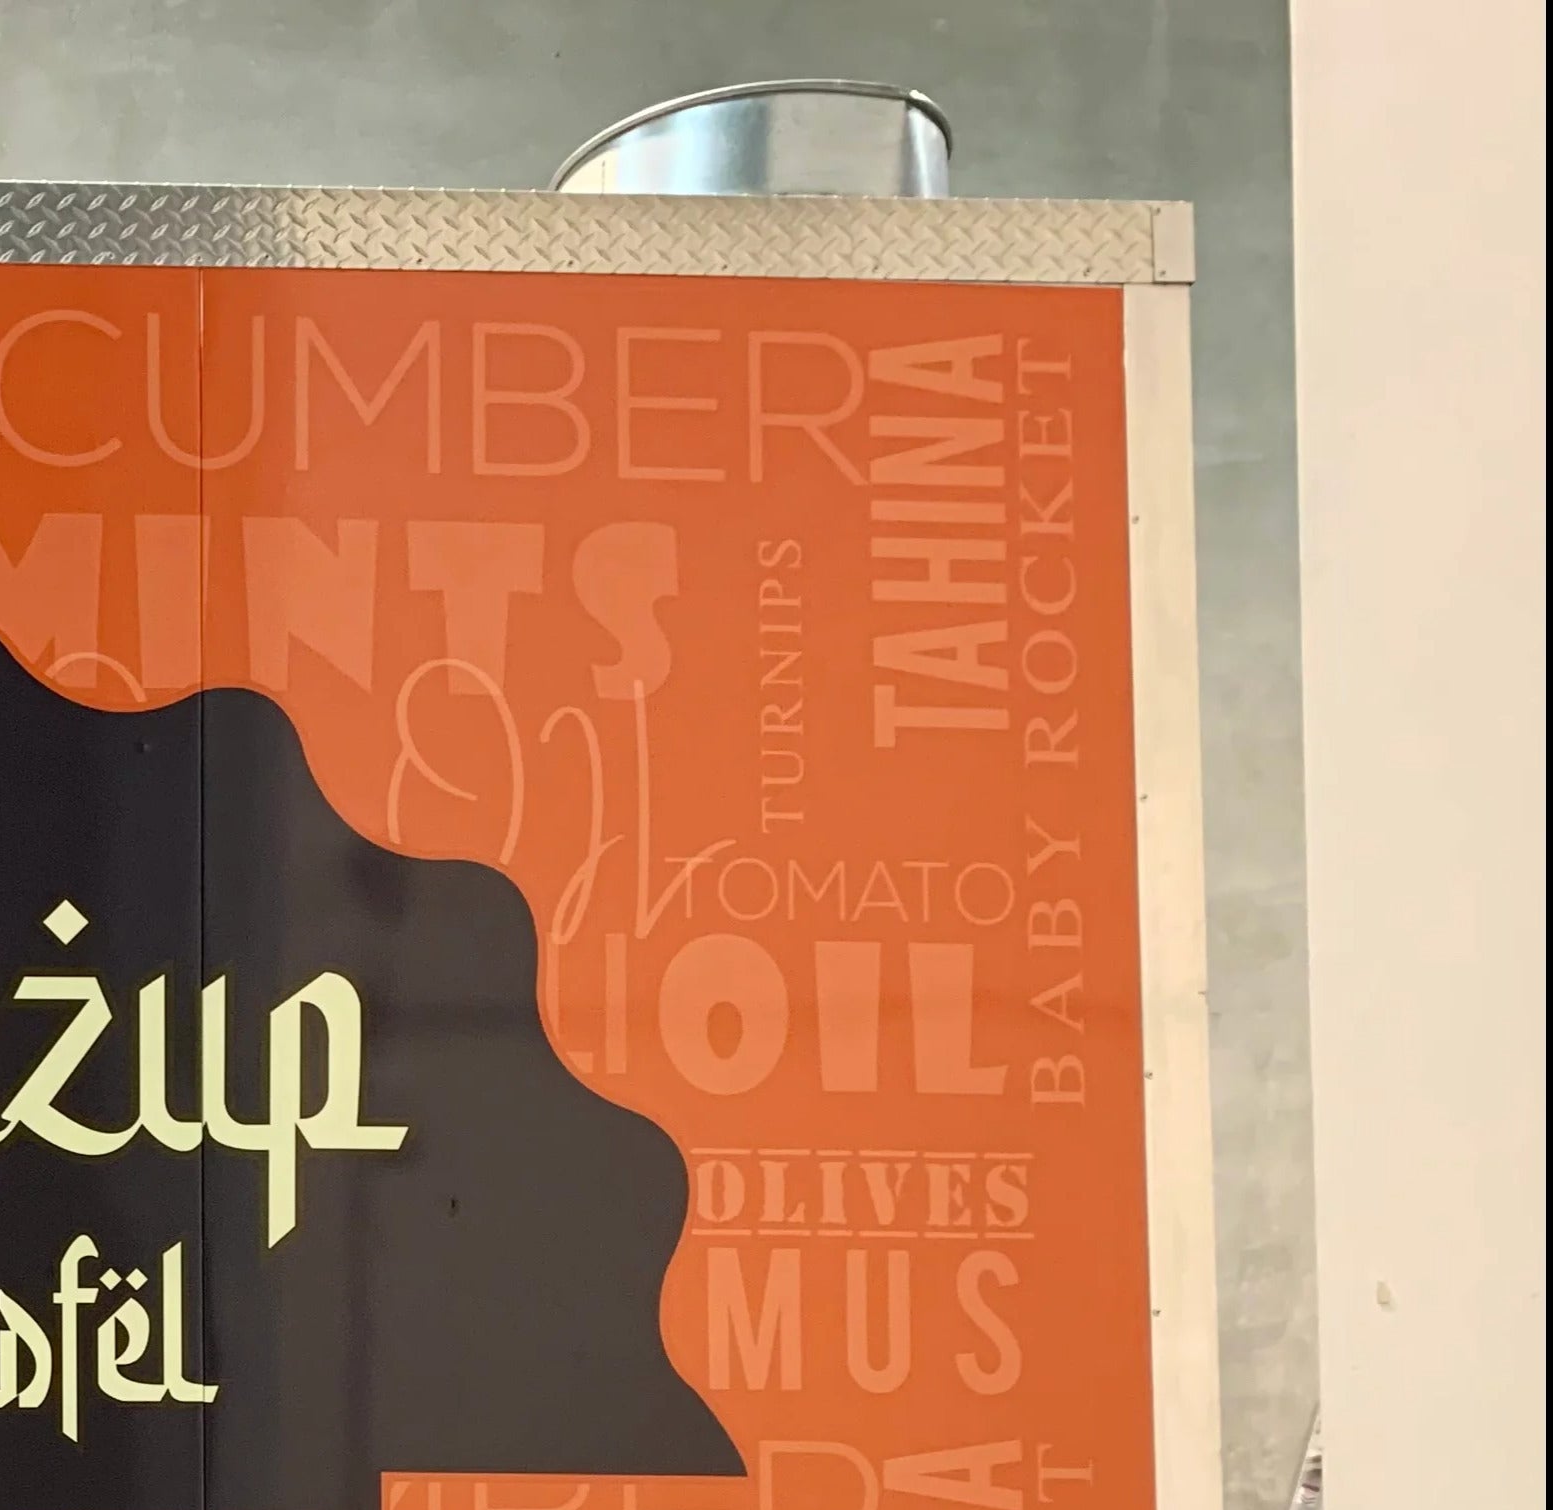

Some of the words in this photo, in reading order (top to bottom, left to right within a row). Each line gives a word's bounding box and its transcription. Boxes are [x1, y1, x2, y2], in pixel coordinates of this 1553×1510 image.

[868, 333, 1010, 748] TAHINA
[1017, 337, 1080, 770] ROCKET
[758, 537, 805, 834] TURNIPS
[664, 857, 1016, 926] TOMATO
[1026, 814, 1087, 1108] BABY
[658, 932, 1009, 1096] OIL
[691, 1158, 1031, 1228] OLIVES
[706, 1246, 1023, 1395] MUS
